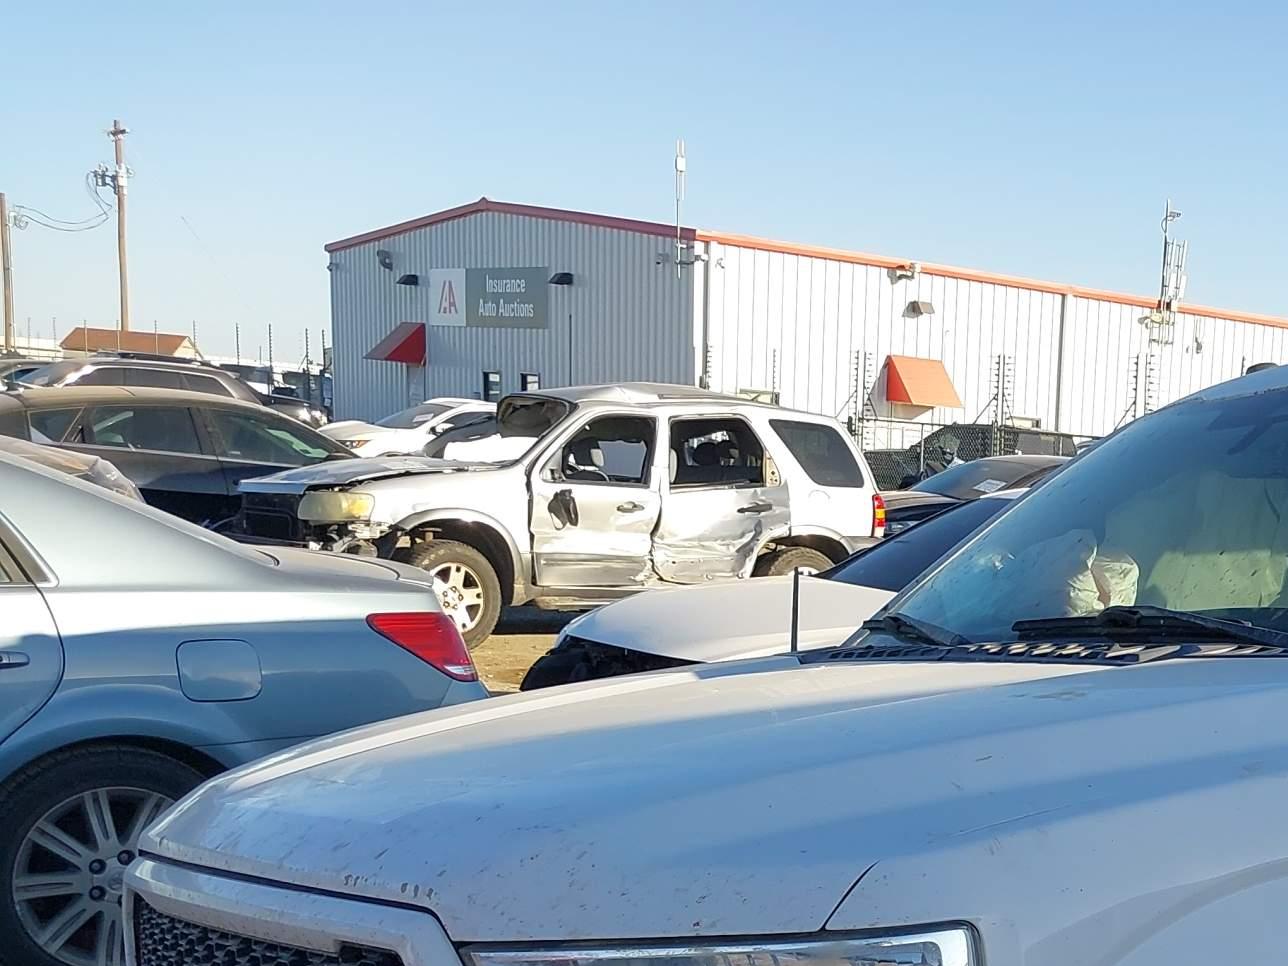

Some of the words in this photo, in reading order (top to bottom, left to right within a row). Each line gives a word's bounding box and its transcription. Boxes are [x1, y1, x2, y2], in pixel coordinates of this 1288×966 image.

[486, 275, 526, 293] Insurance
[479, 299, 497, 317] Auto
[499, 299, 534, 317] Auctions
